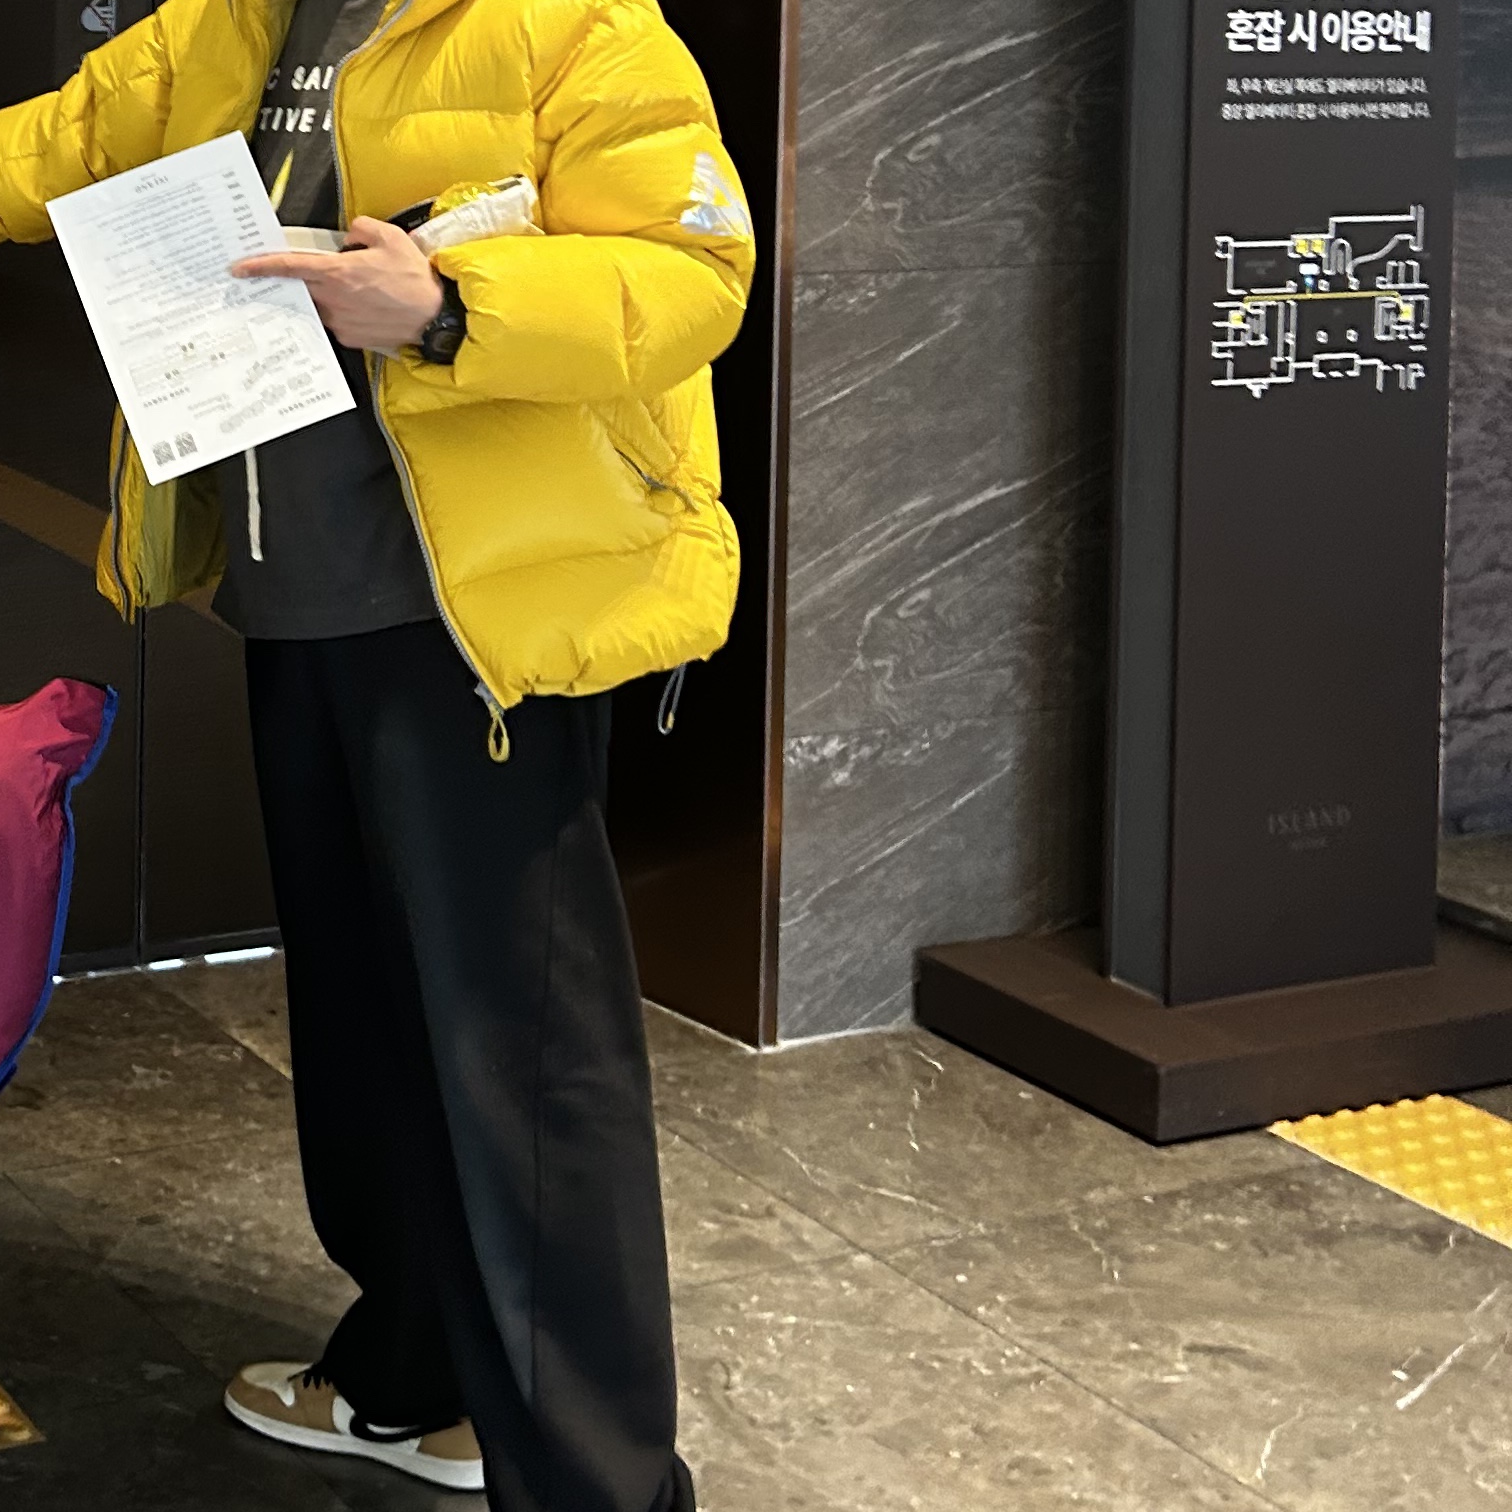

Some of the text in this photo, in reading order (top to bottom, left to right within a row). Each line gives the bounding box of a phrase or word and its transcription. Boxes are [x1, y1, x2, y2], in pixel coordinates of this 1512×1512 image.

[1225, 9, 1432, 53] 혼잡 시 이용안내
